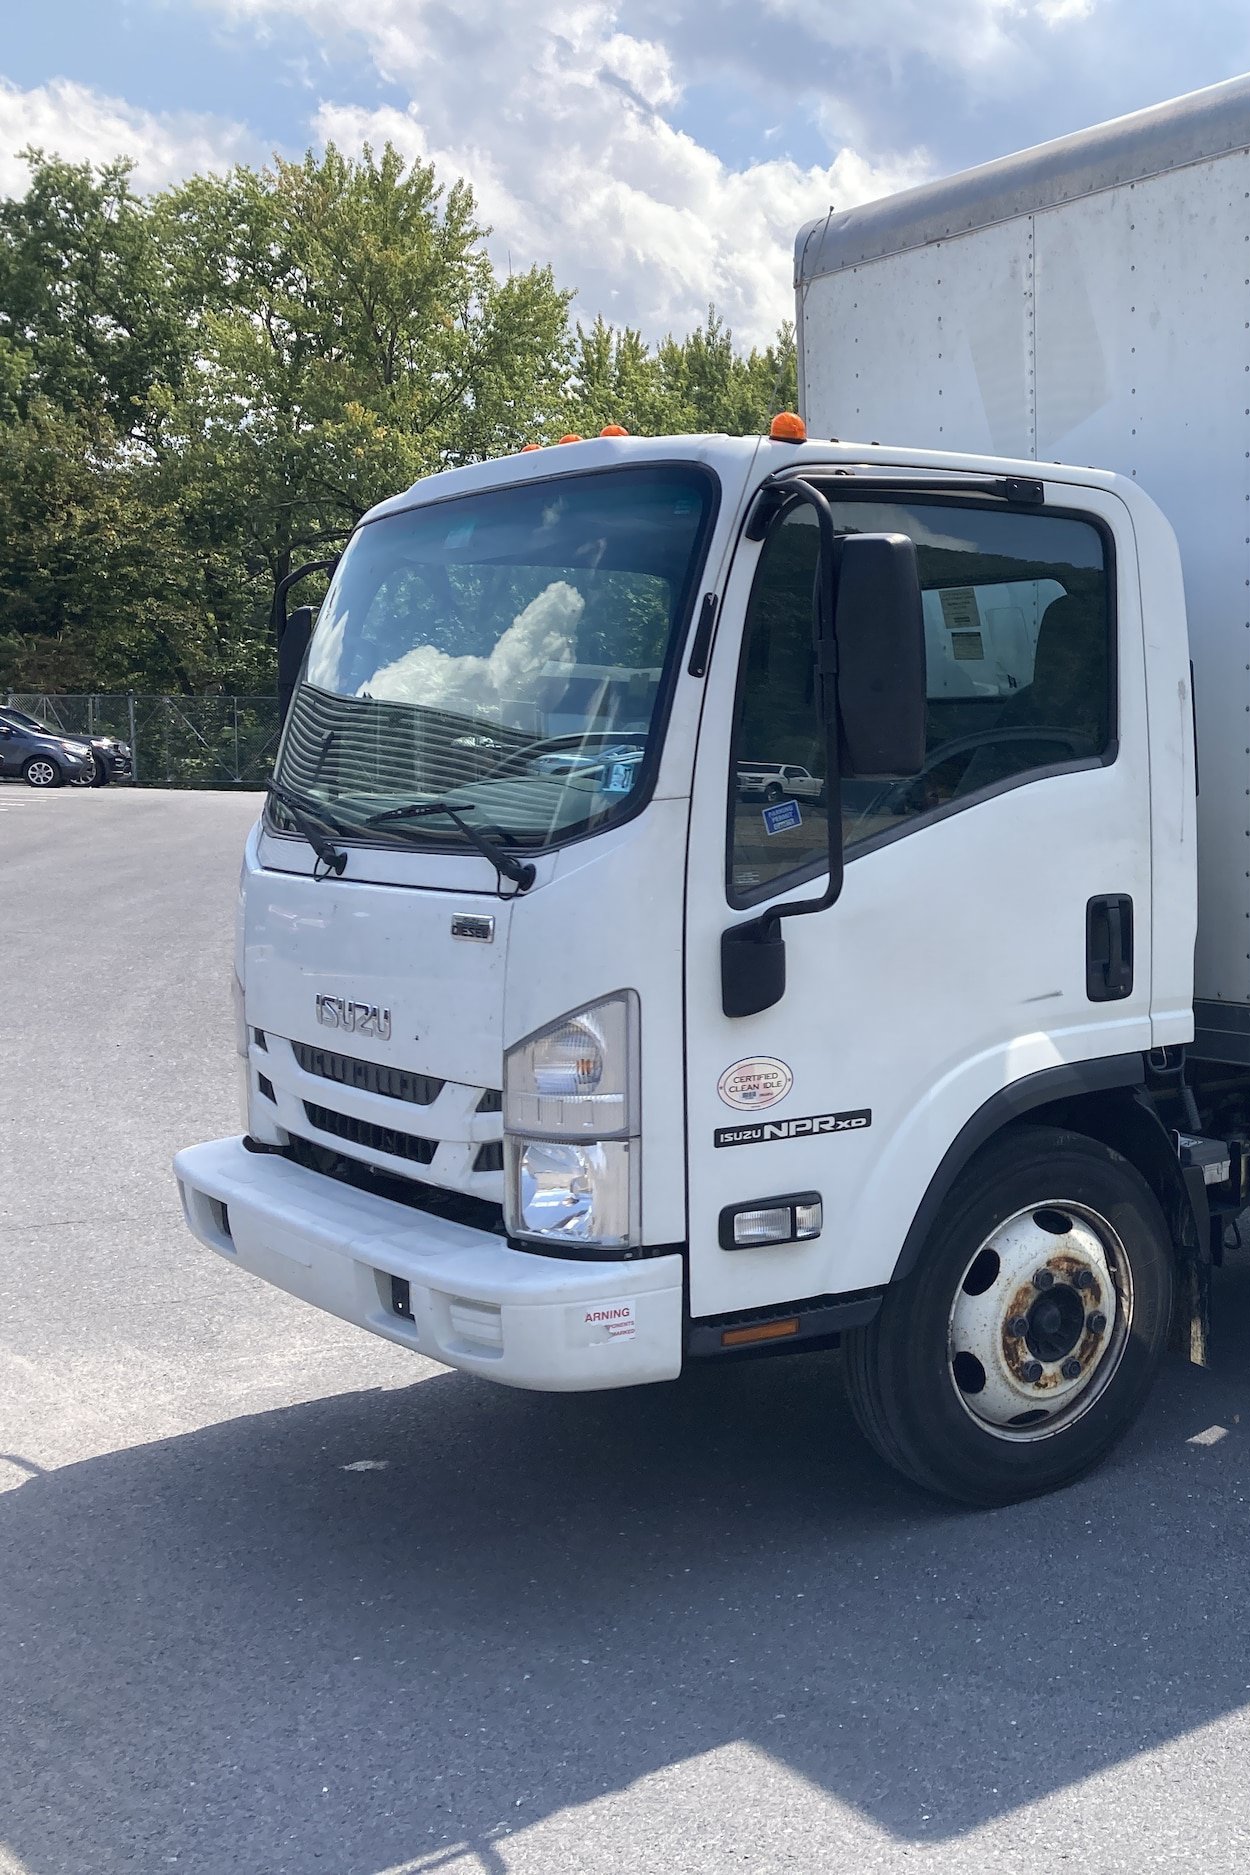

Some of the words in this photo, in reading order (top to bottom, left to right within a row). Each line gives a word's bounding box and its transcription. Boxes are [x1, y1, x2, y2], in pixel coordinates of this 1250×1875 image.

[316, 993, 392, 1041] ISUZU
[733, 1072, 779, 1084] CERTIFIED
[728, 1083, 760, 1093] CLEAN
[763, 1080, 783, 1089] IDLE
[720, 1128, 762, 1143] ISUZU
